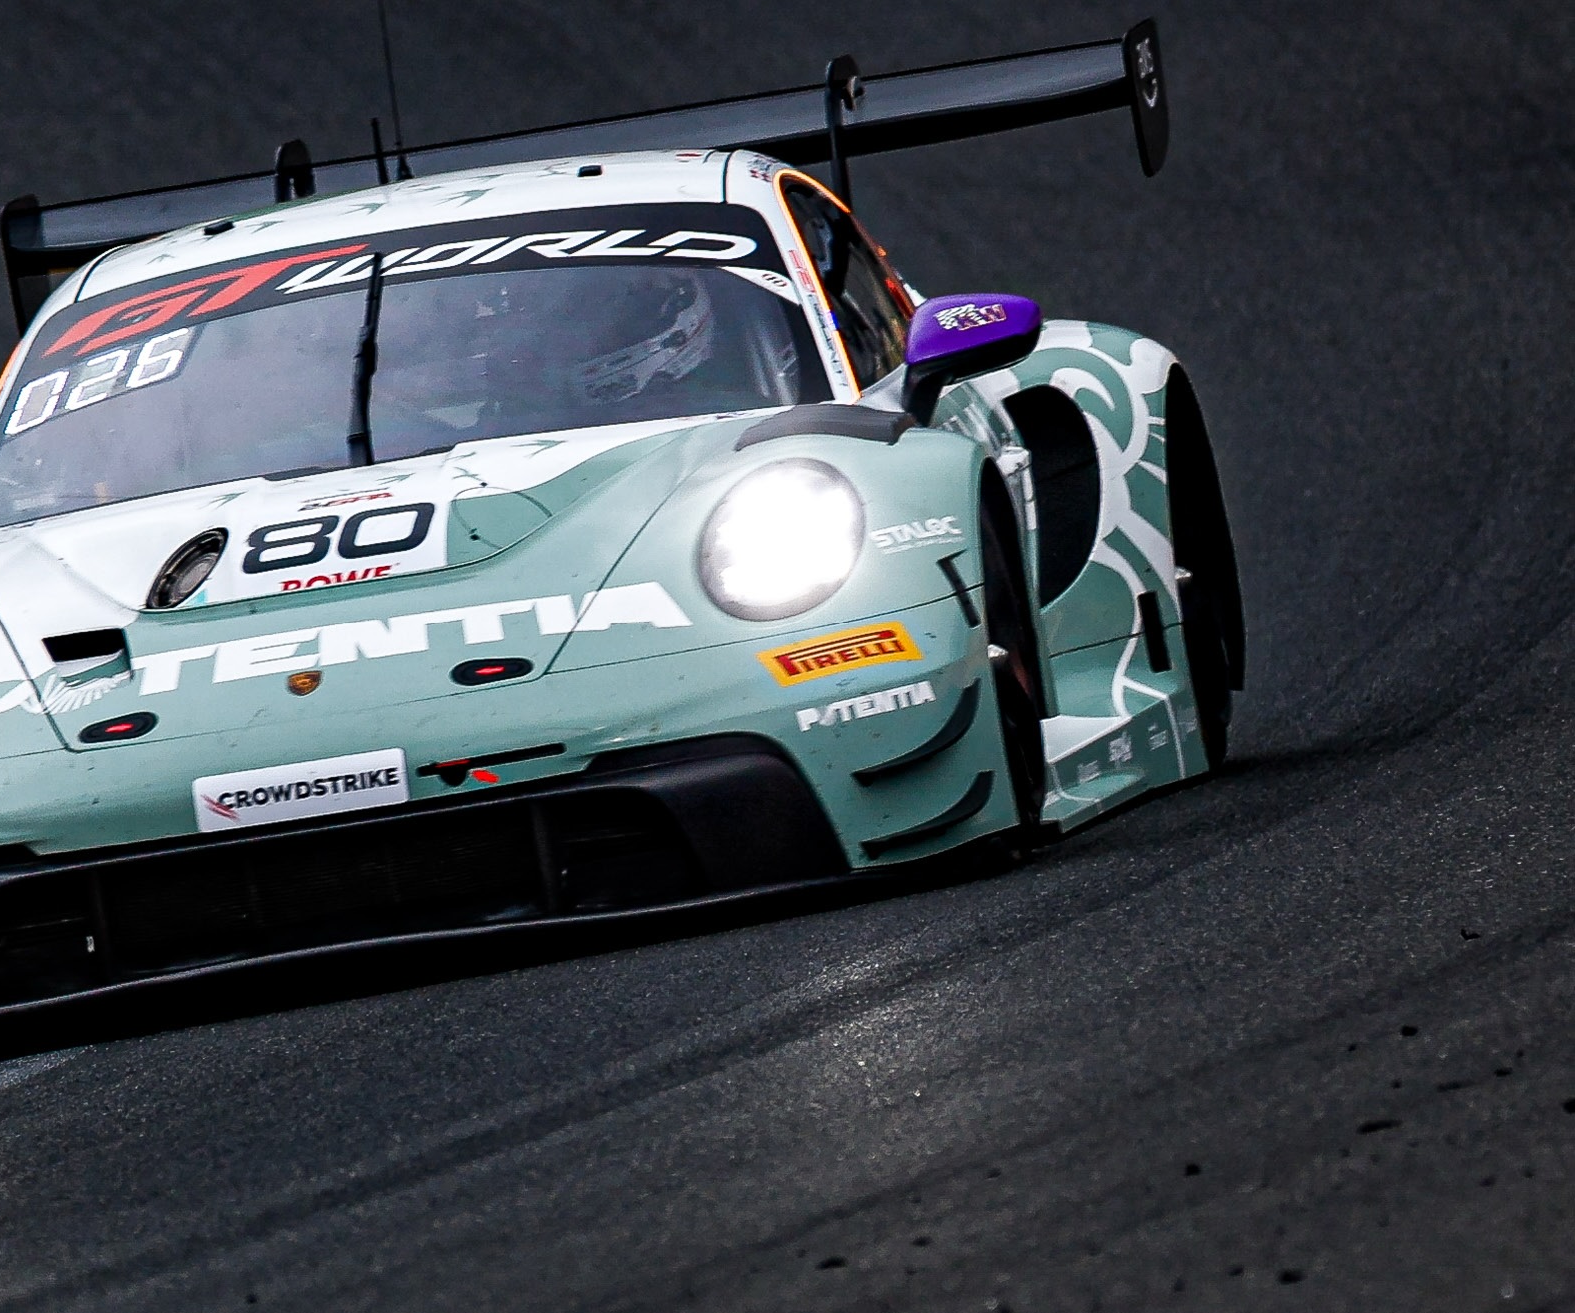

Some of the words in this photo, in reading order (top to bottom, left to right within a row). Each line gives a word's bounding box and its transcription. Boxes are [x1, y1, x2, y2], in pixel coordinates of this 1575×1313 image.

[42, 244, 368, 356] GT
[276, 229, 757, 294] WORLD
[4, 328, 189, 435] 026
[242, 502, 435, 575] 80
[774, 628, 907, 677] PIRELLI
[219, 767, 400, 809] CROWDSTRIKE
